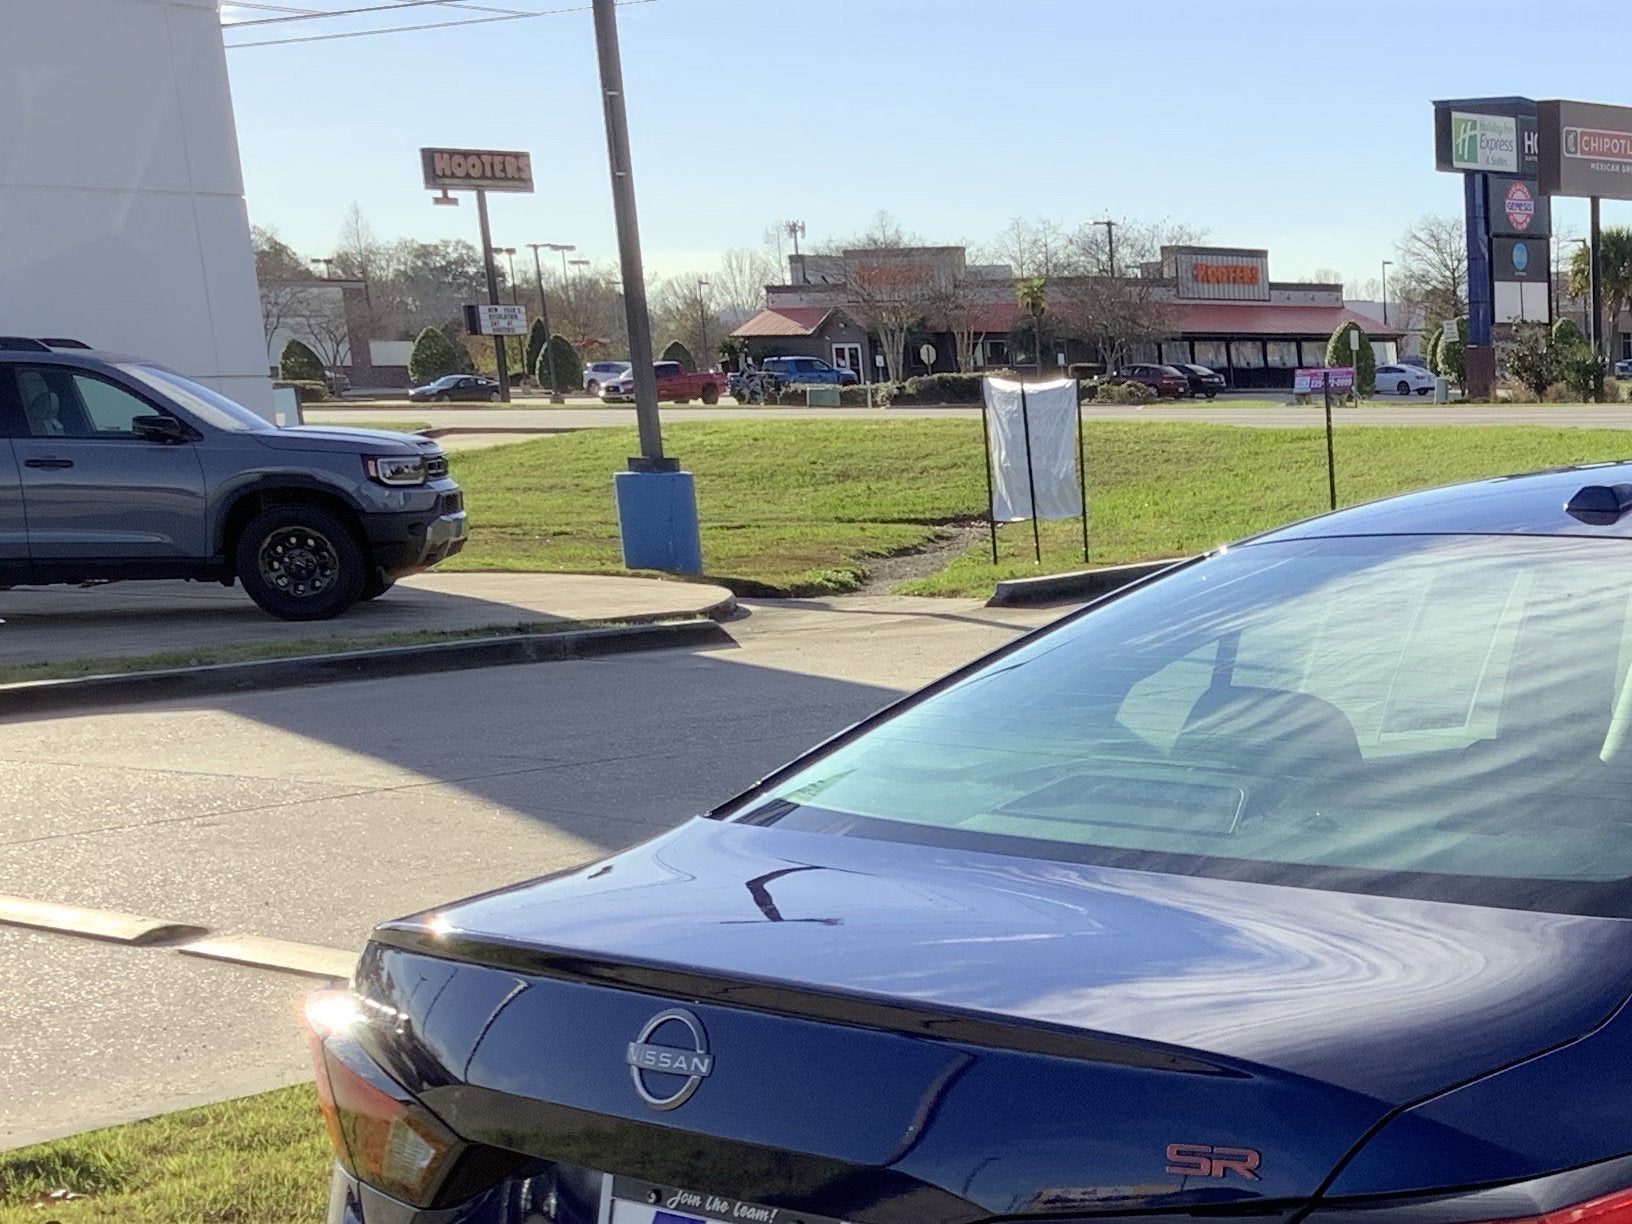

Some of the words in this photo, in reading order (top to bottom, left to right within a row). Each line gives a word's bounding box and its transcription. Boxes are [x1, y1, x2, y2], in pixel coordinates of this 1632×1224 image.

[1480, 133, 1514, 154] Express
[432, 152, 530, 179] HOOTERS
[1590, 162, 1619, 173] MEXICAN
[1507, 201, 1532, 212] GENESIS
[1194, 262, 1259, 285] HOOTERS
[629, 1042, 710, 1074] NISSAN
[1166, 1143, 1260, 1181] SR
[666, 1189, 701, 1209] Join
[705, 1196, 730, 1214] the
[733, 1201, 779, 1224] team!
